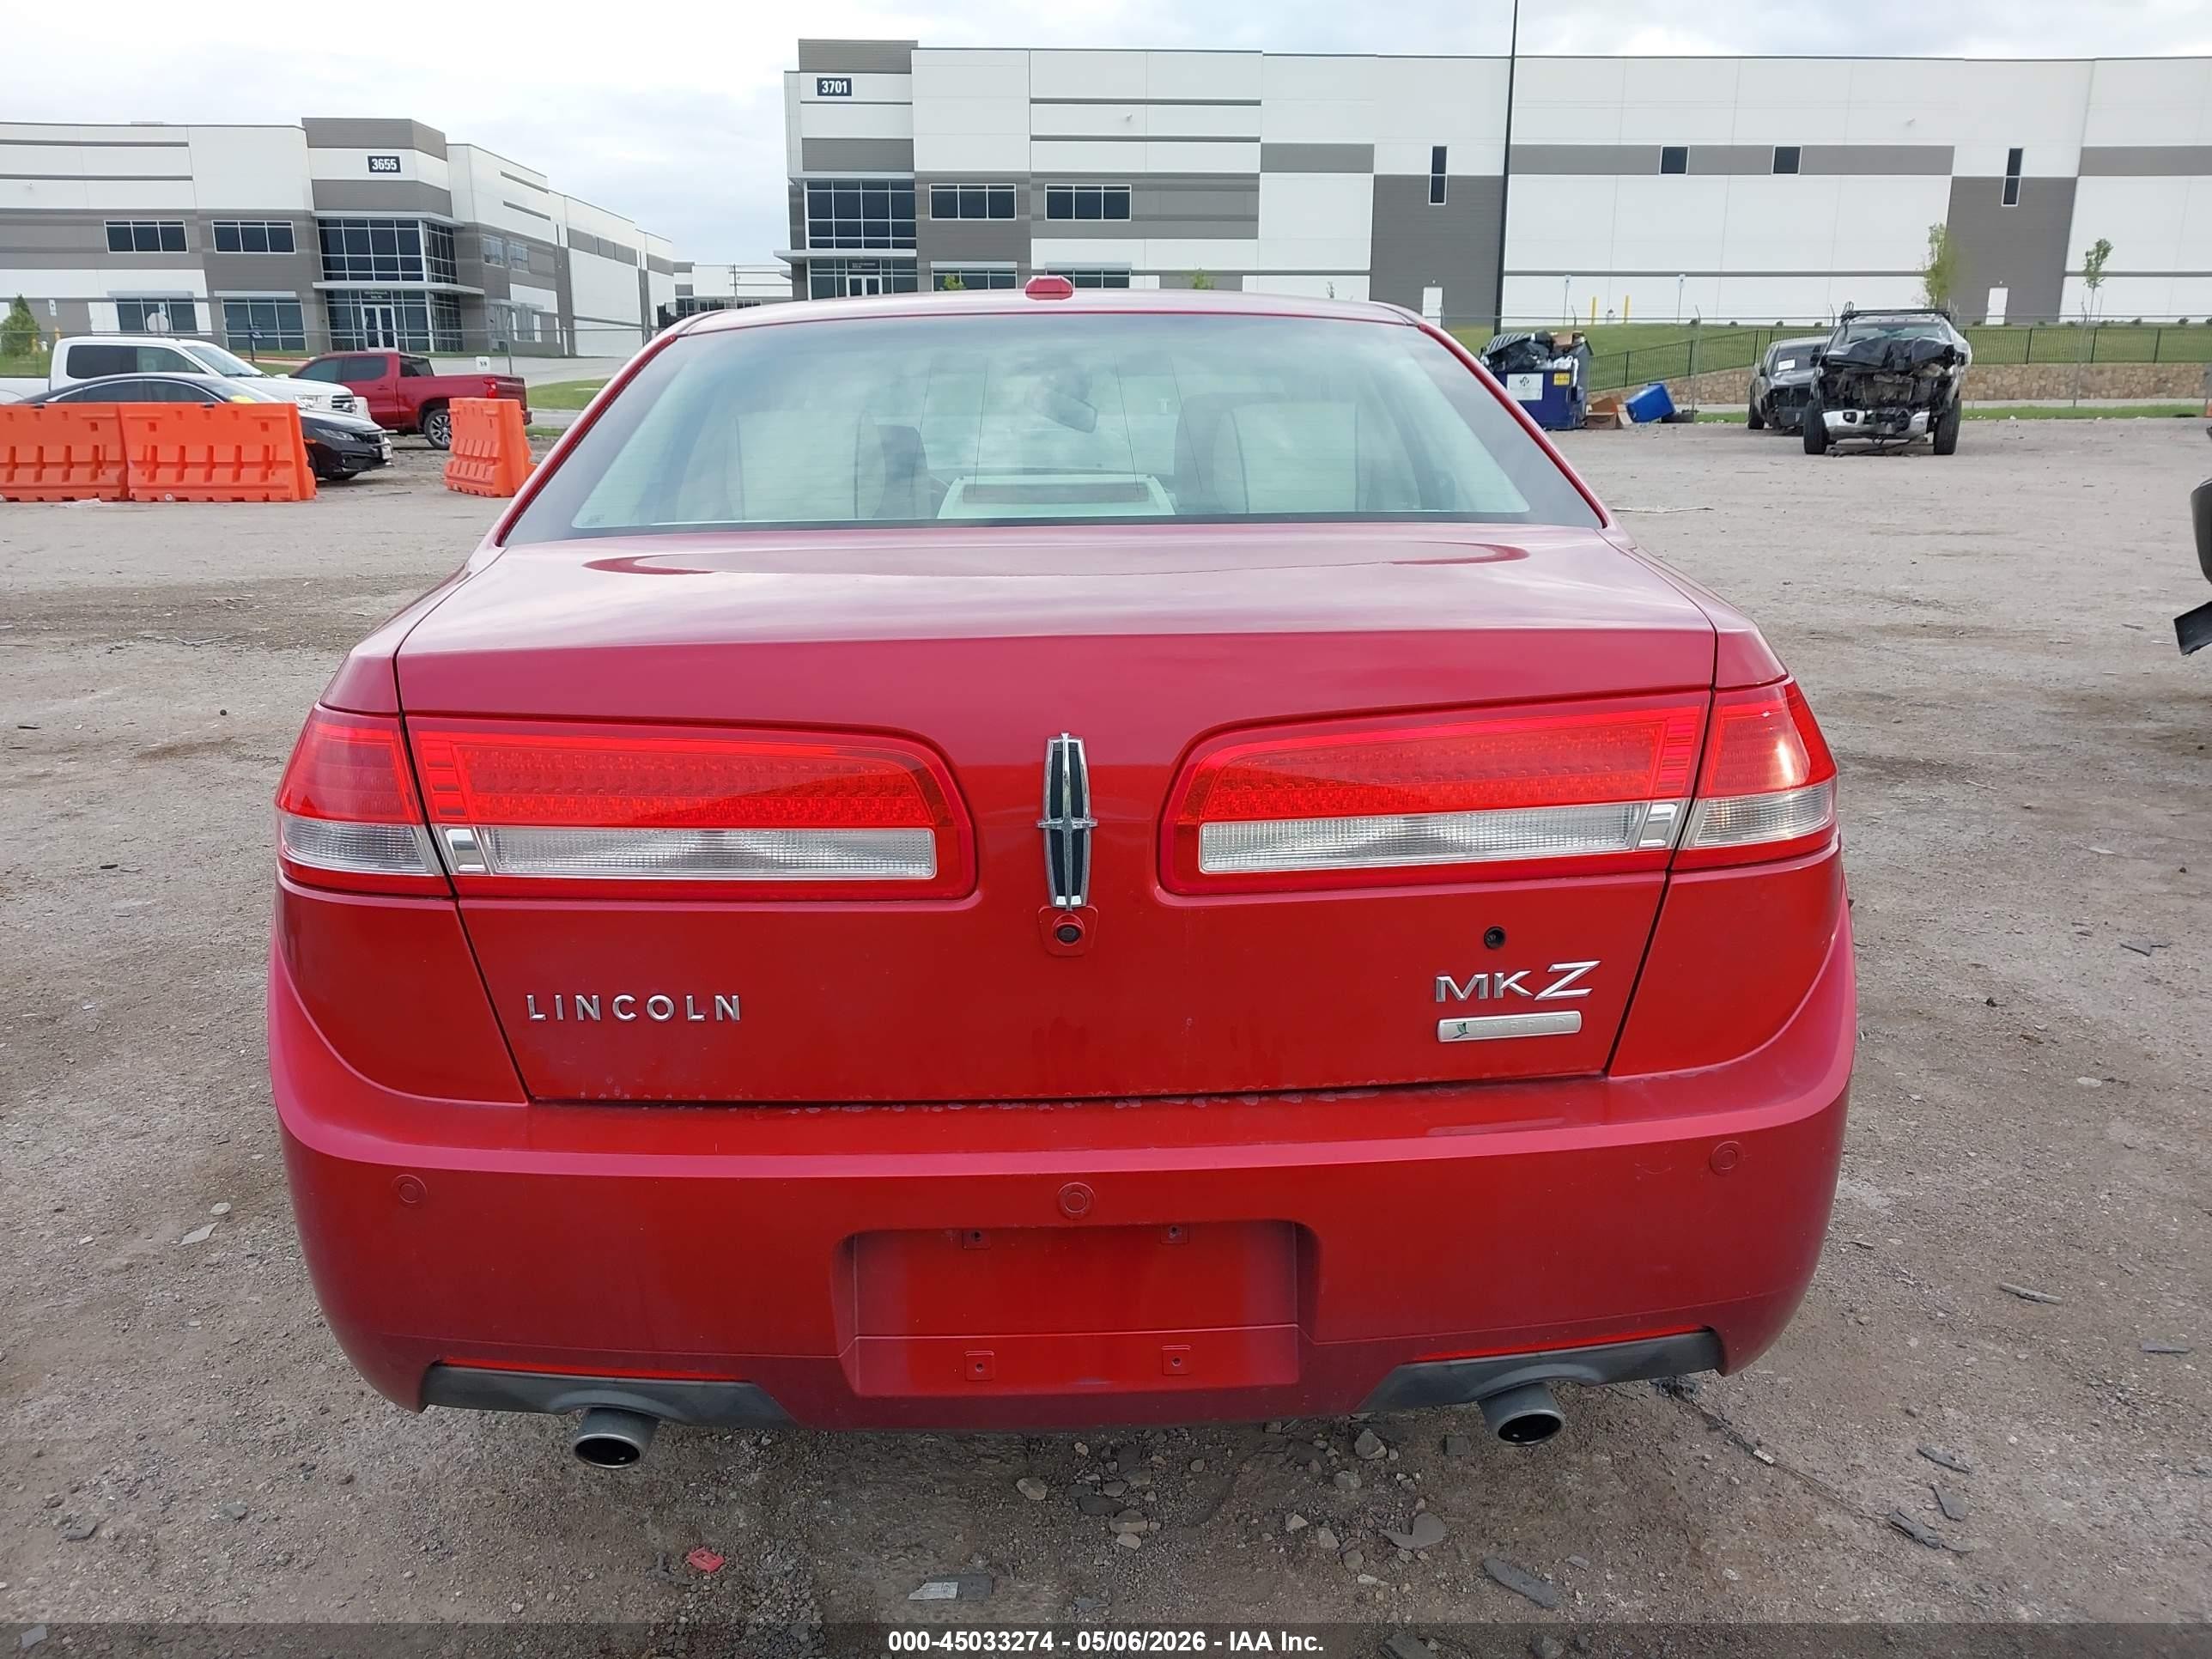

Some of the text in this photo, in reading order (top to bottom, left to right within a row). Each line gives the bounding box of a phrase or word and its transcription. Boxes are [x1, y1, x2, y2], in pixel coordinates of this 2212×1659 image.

[822, 80, 848, 94] 3701
[371, 158, 397, 171] 3655
[1436, 960, 1601, 1003] MKZ
[526, 994, 741, 1022] LINCOLN
